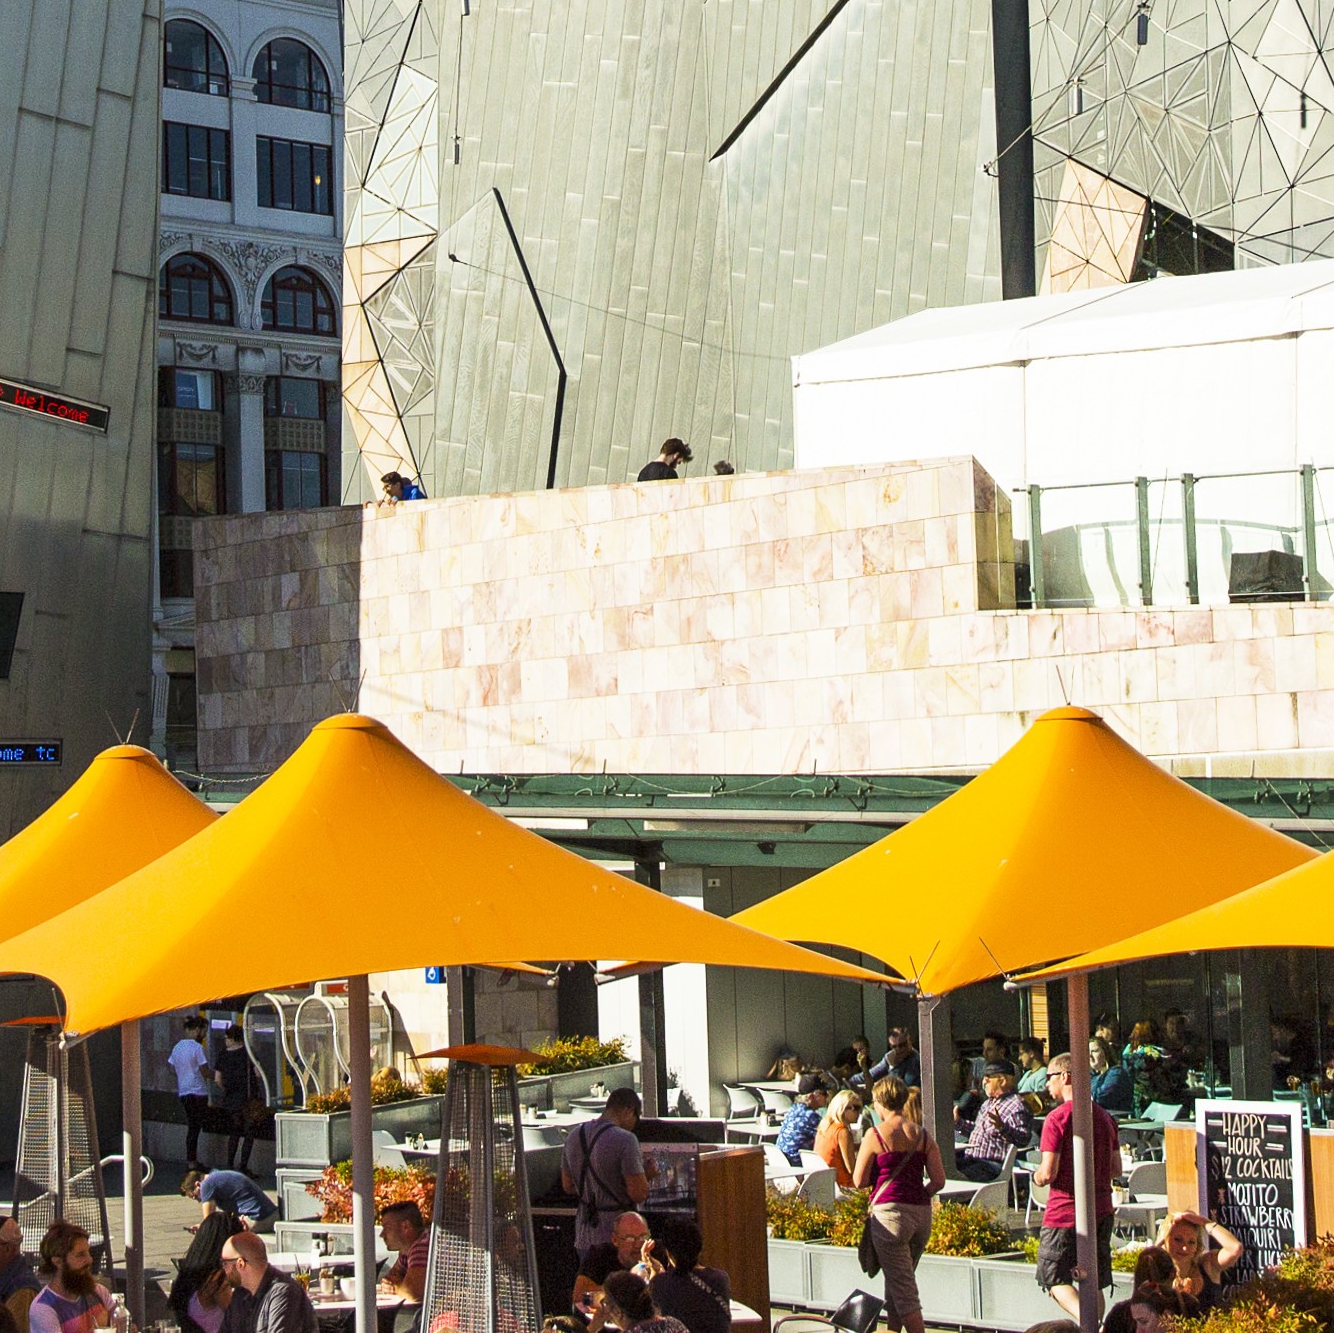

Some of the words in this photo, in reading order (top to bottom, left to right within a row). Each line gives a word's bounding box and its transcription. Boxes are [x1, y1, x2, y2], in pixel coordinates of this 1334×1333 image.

[13, 388, 88, 422] Welcome
[1222, 1112, 1267, 1139] HAPPY
[1228, 1136, 1263, 1158] HOUR
[1227, 1182, 1279, 1206] MOJITO
